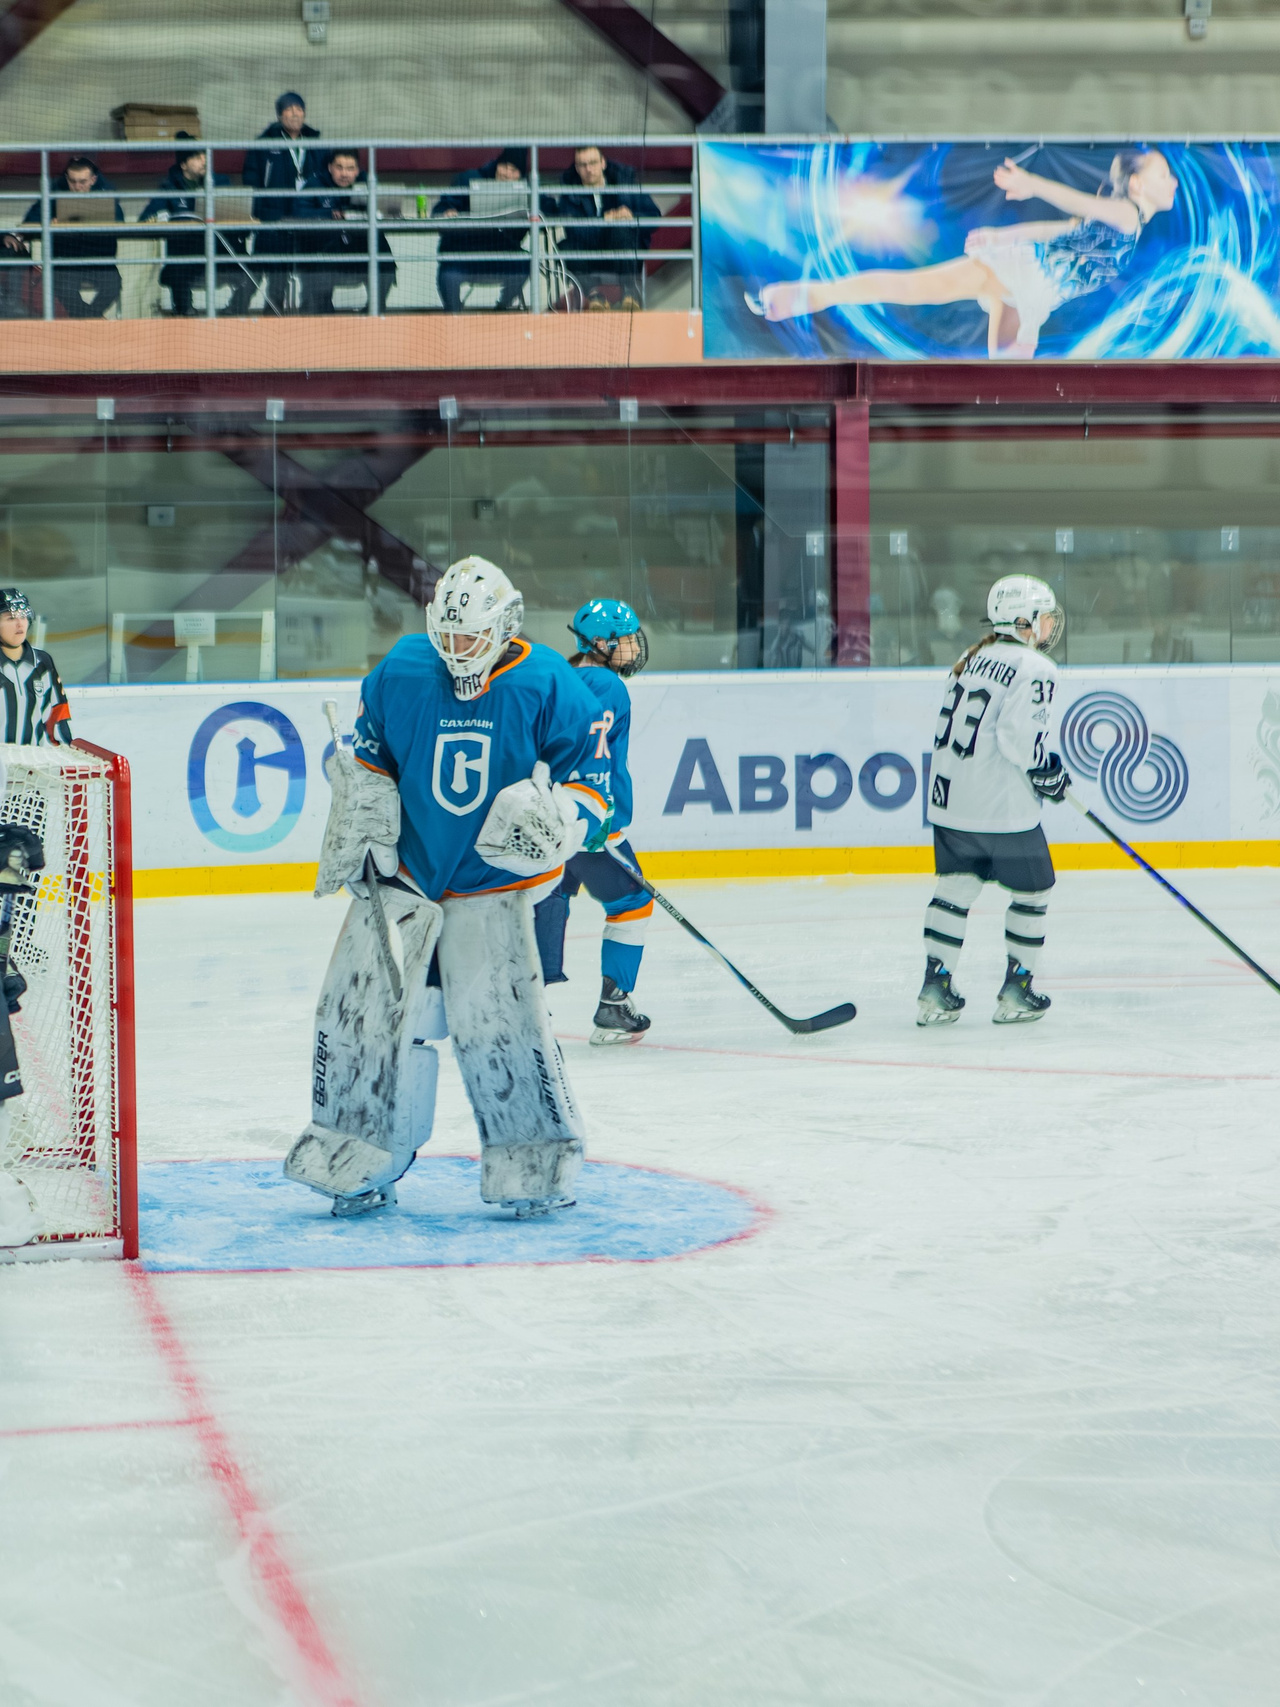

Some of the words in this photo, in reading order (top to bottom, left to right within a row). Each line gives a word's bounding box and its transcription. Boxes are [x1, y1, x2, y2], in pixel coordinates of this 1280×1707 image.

[439, 718, 494, 730] САХАЛИН
[933, 681, 992, 761] 33
[315, 1030, 329, 1107] BAUER
[532, 1048, 562, 1124] BAUER
